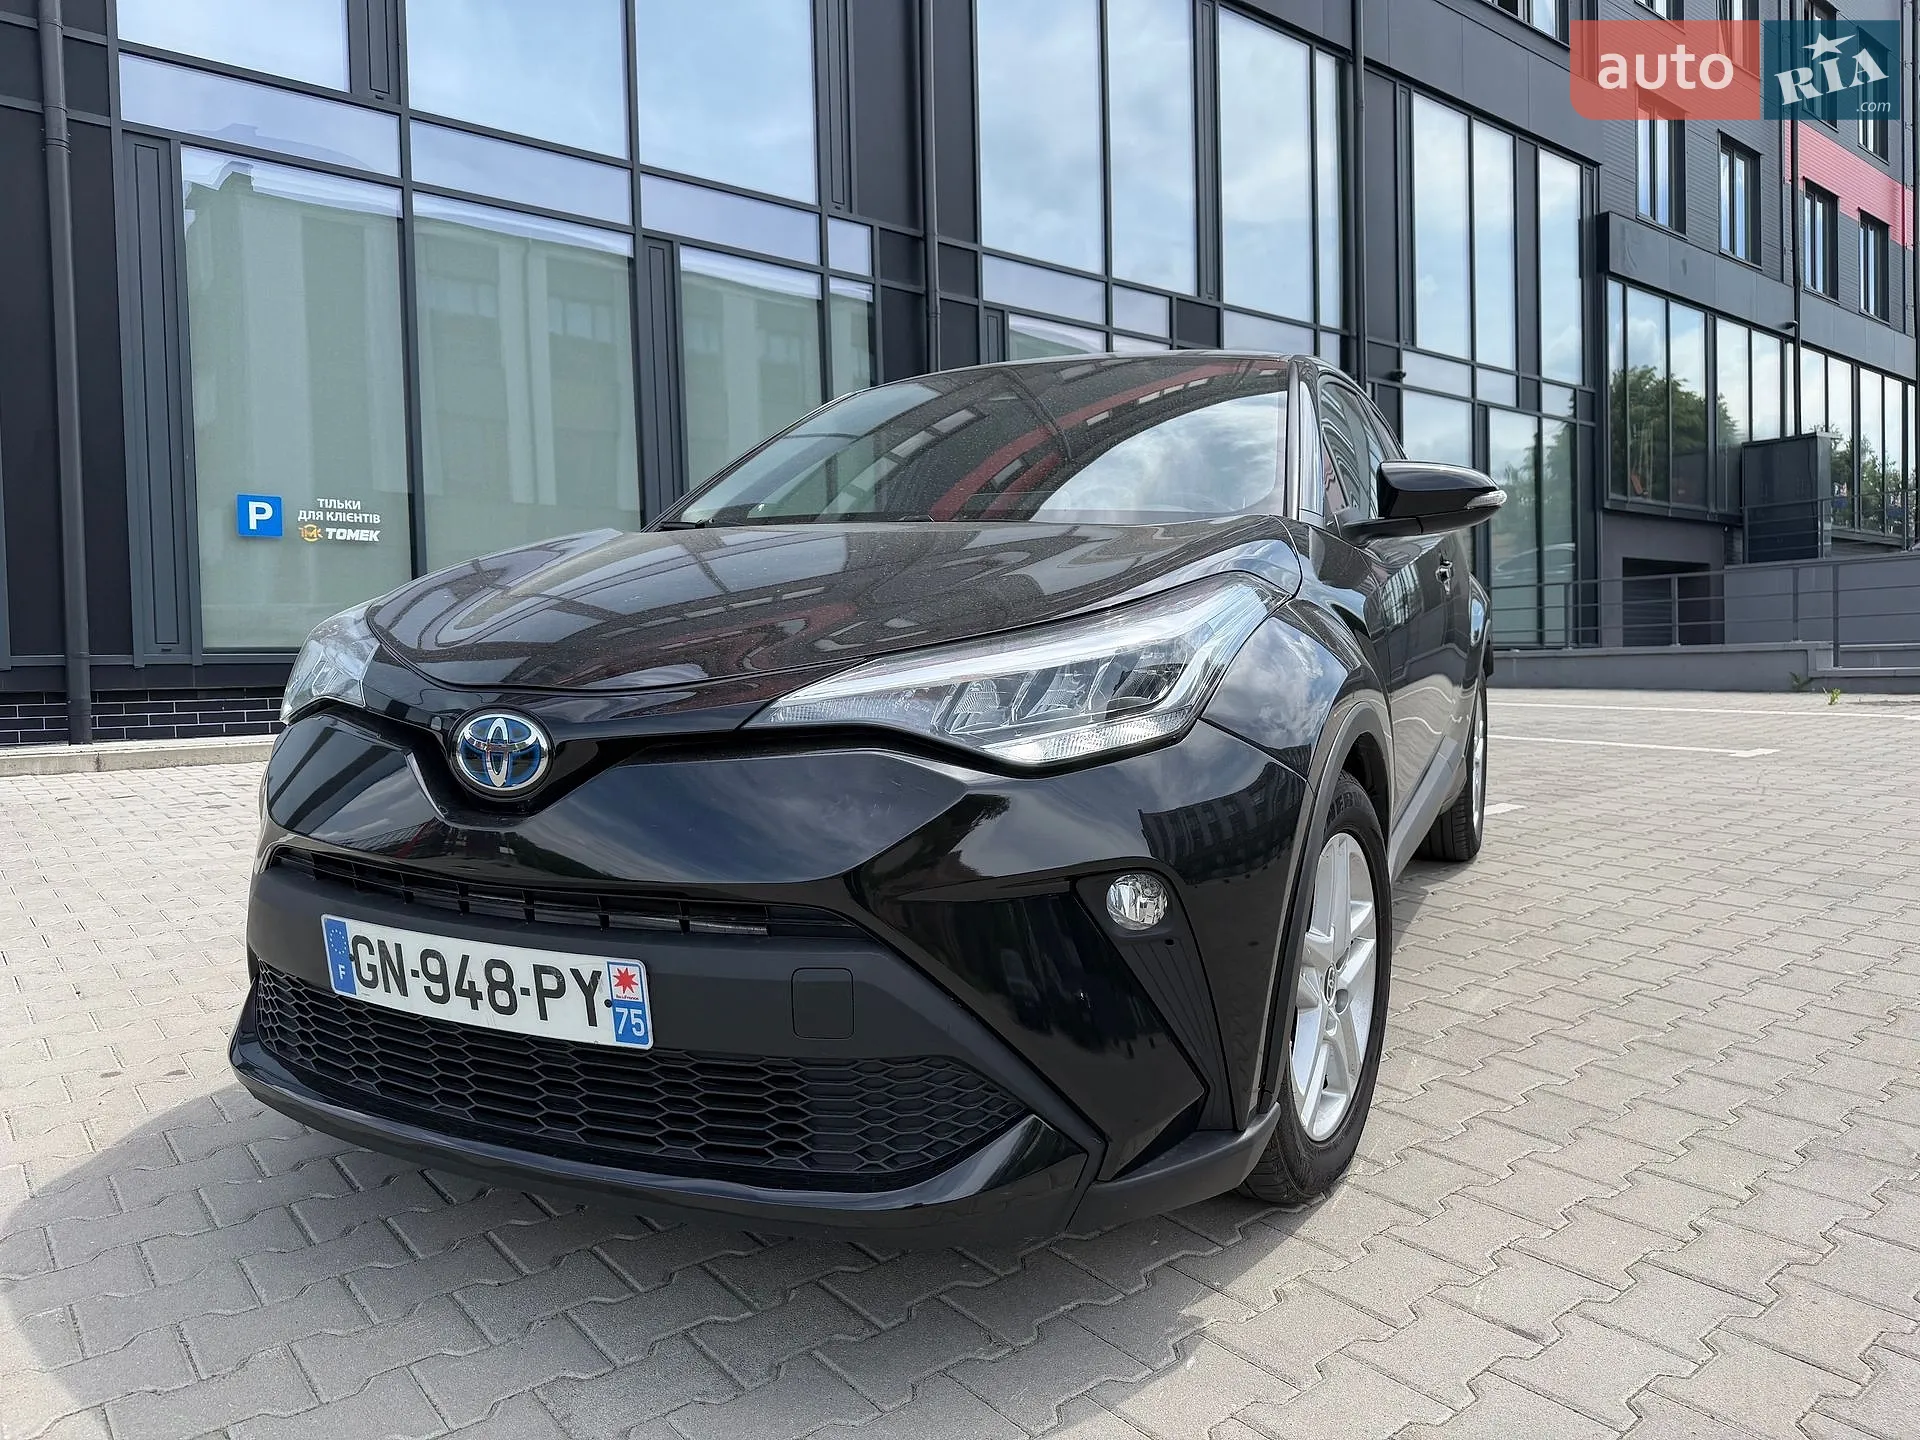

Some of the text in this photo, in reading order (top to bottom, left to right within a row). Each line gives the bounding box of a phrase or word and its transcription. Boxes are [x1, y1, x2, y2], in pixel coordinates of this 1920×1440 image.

[248, 501, 273, 530] P
[317, 498, 361, 510] ТІЛЬКИ
[298, 510, 381, 524] ДЛЯ КЛІЄНТІВ
[337, 964, 346, 981] F
[351, 934, 603, 1028] GN-948-PY
[615, 1007, 645, 1037] 75
